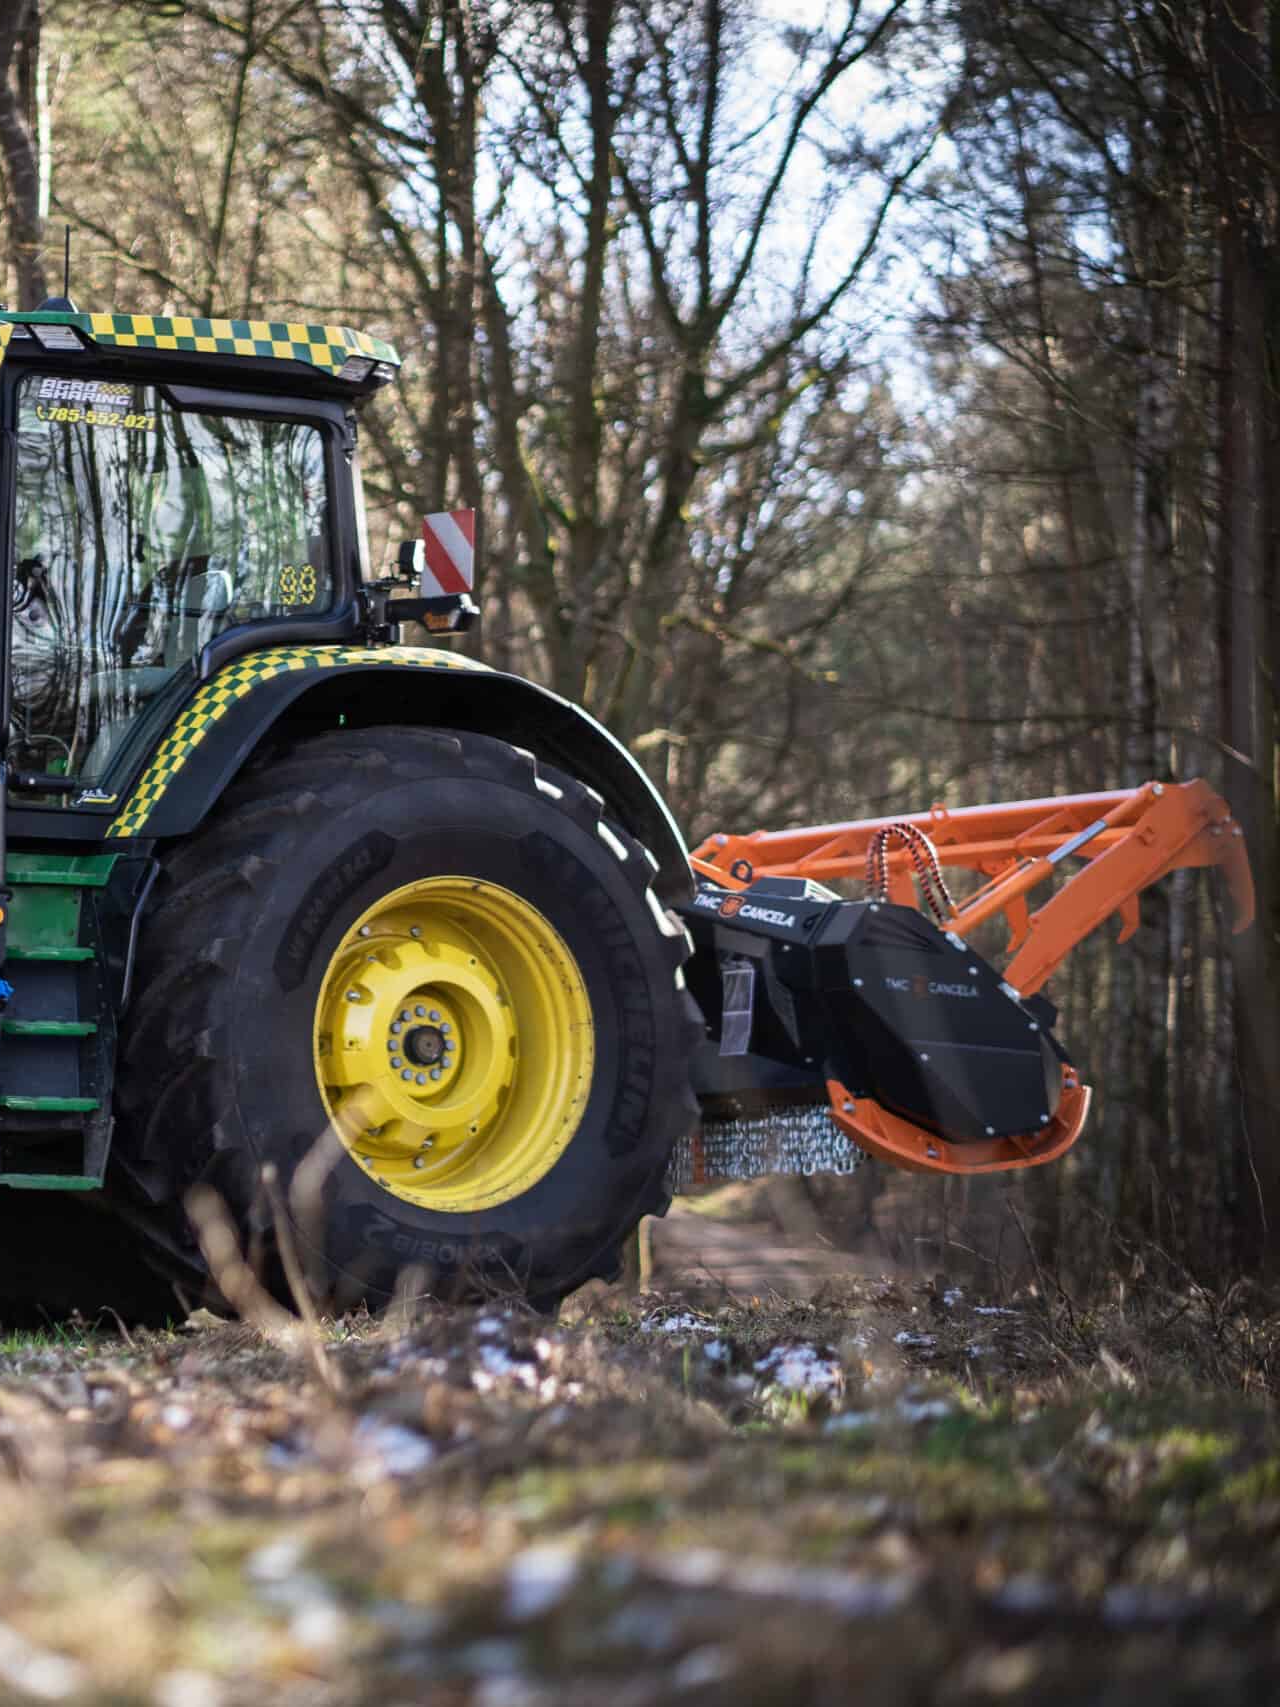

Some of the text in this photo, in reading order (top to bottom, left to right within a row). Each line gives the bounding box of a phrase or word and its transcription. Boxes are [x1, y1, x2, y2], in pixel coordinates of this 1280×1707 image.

[38, 389, 131, 405] SHARING
[40, 379, 98, 392] AGRO
[47, 406, 156, 430] 785-552-021
[280, 565, 316, 605] 99
[694, 893, 795, 928] TMC CANCELA
